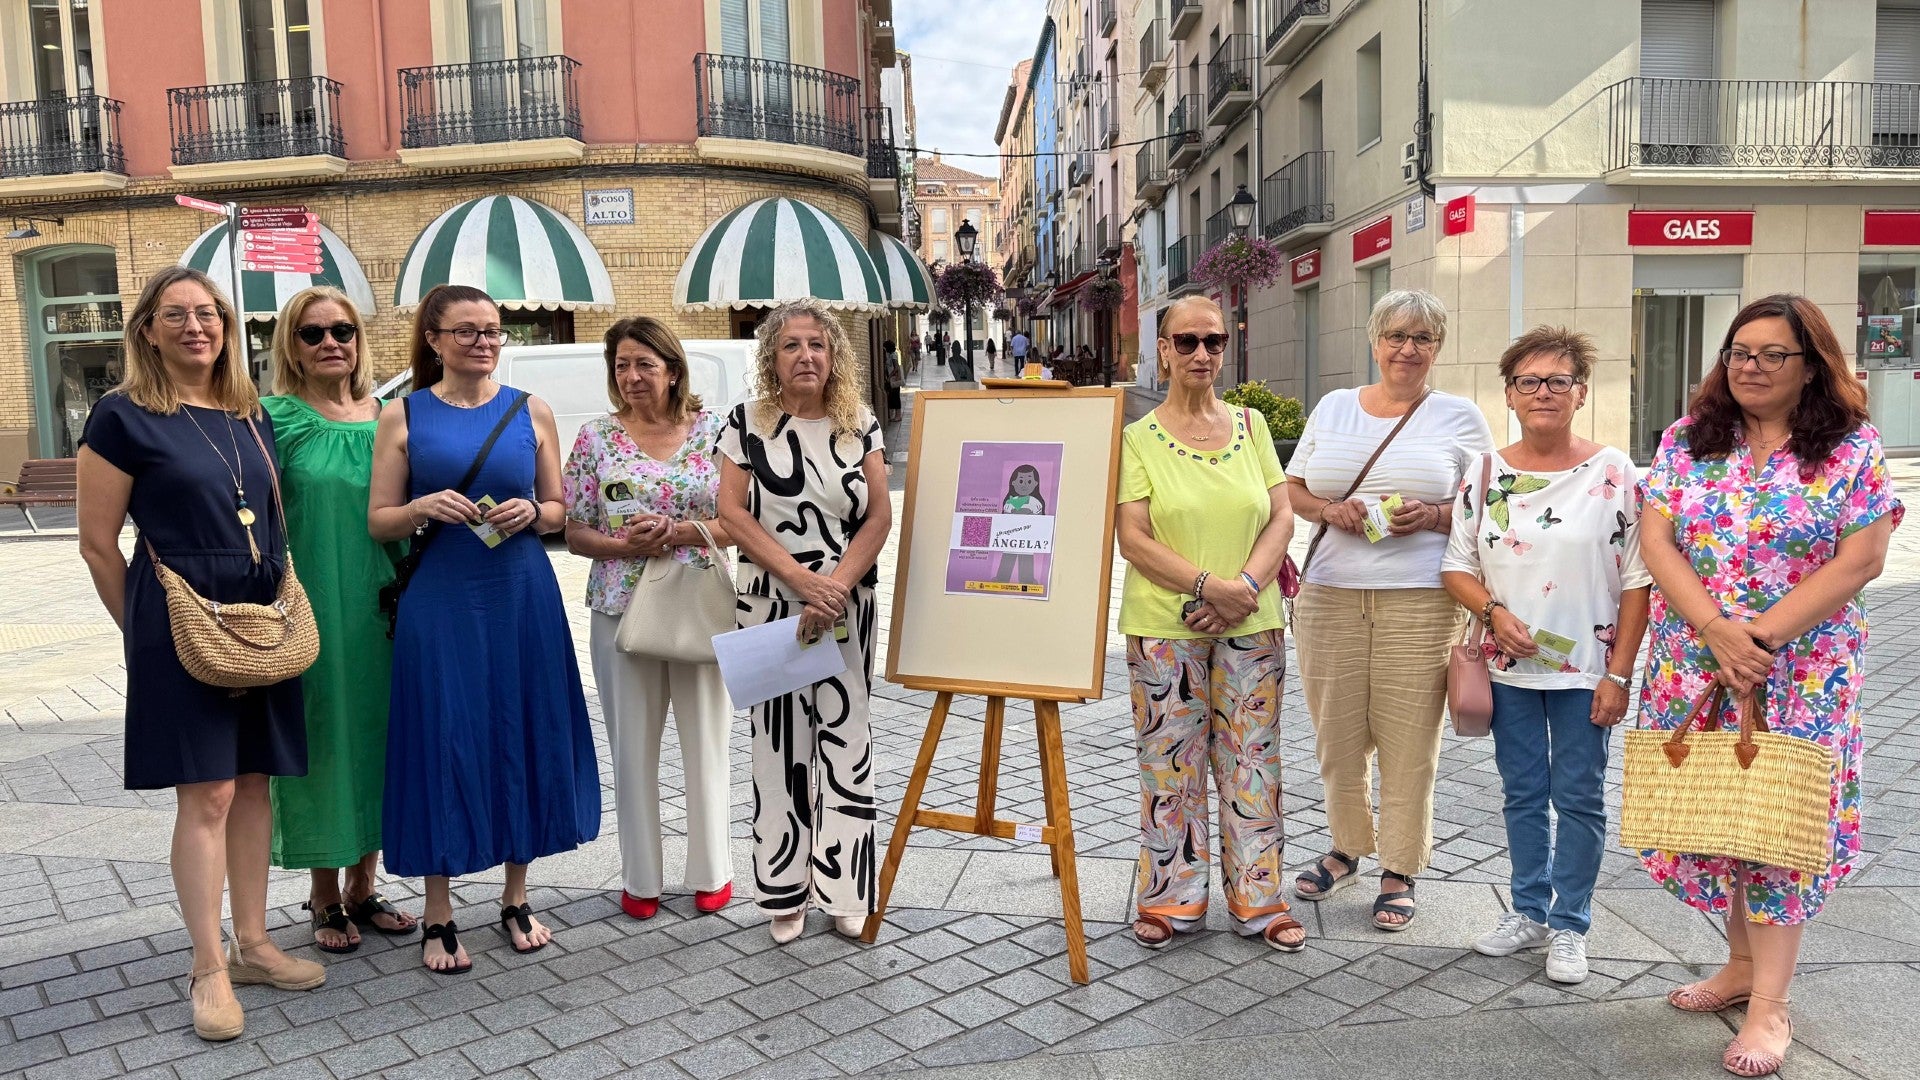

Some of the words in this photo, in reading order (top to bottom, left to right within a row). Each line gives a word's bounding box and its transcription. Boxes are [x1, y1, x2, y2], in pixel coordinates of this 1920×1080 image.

[601, 195, 625, 203] COSO
[592, 210, 627, 219] ALTO
[1449, 207, 1465, 220] GAES
[1663, 219, 1721, 240] GAES
[1871, 341, 1885, 350] 2x1
